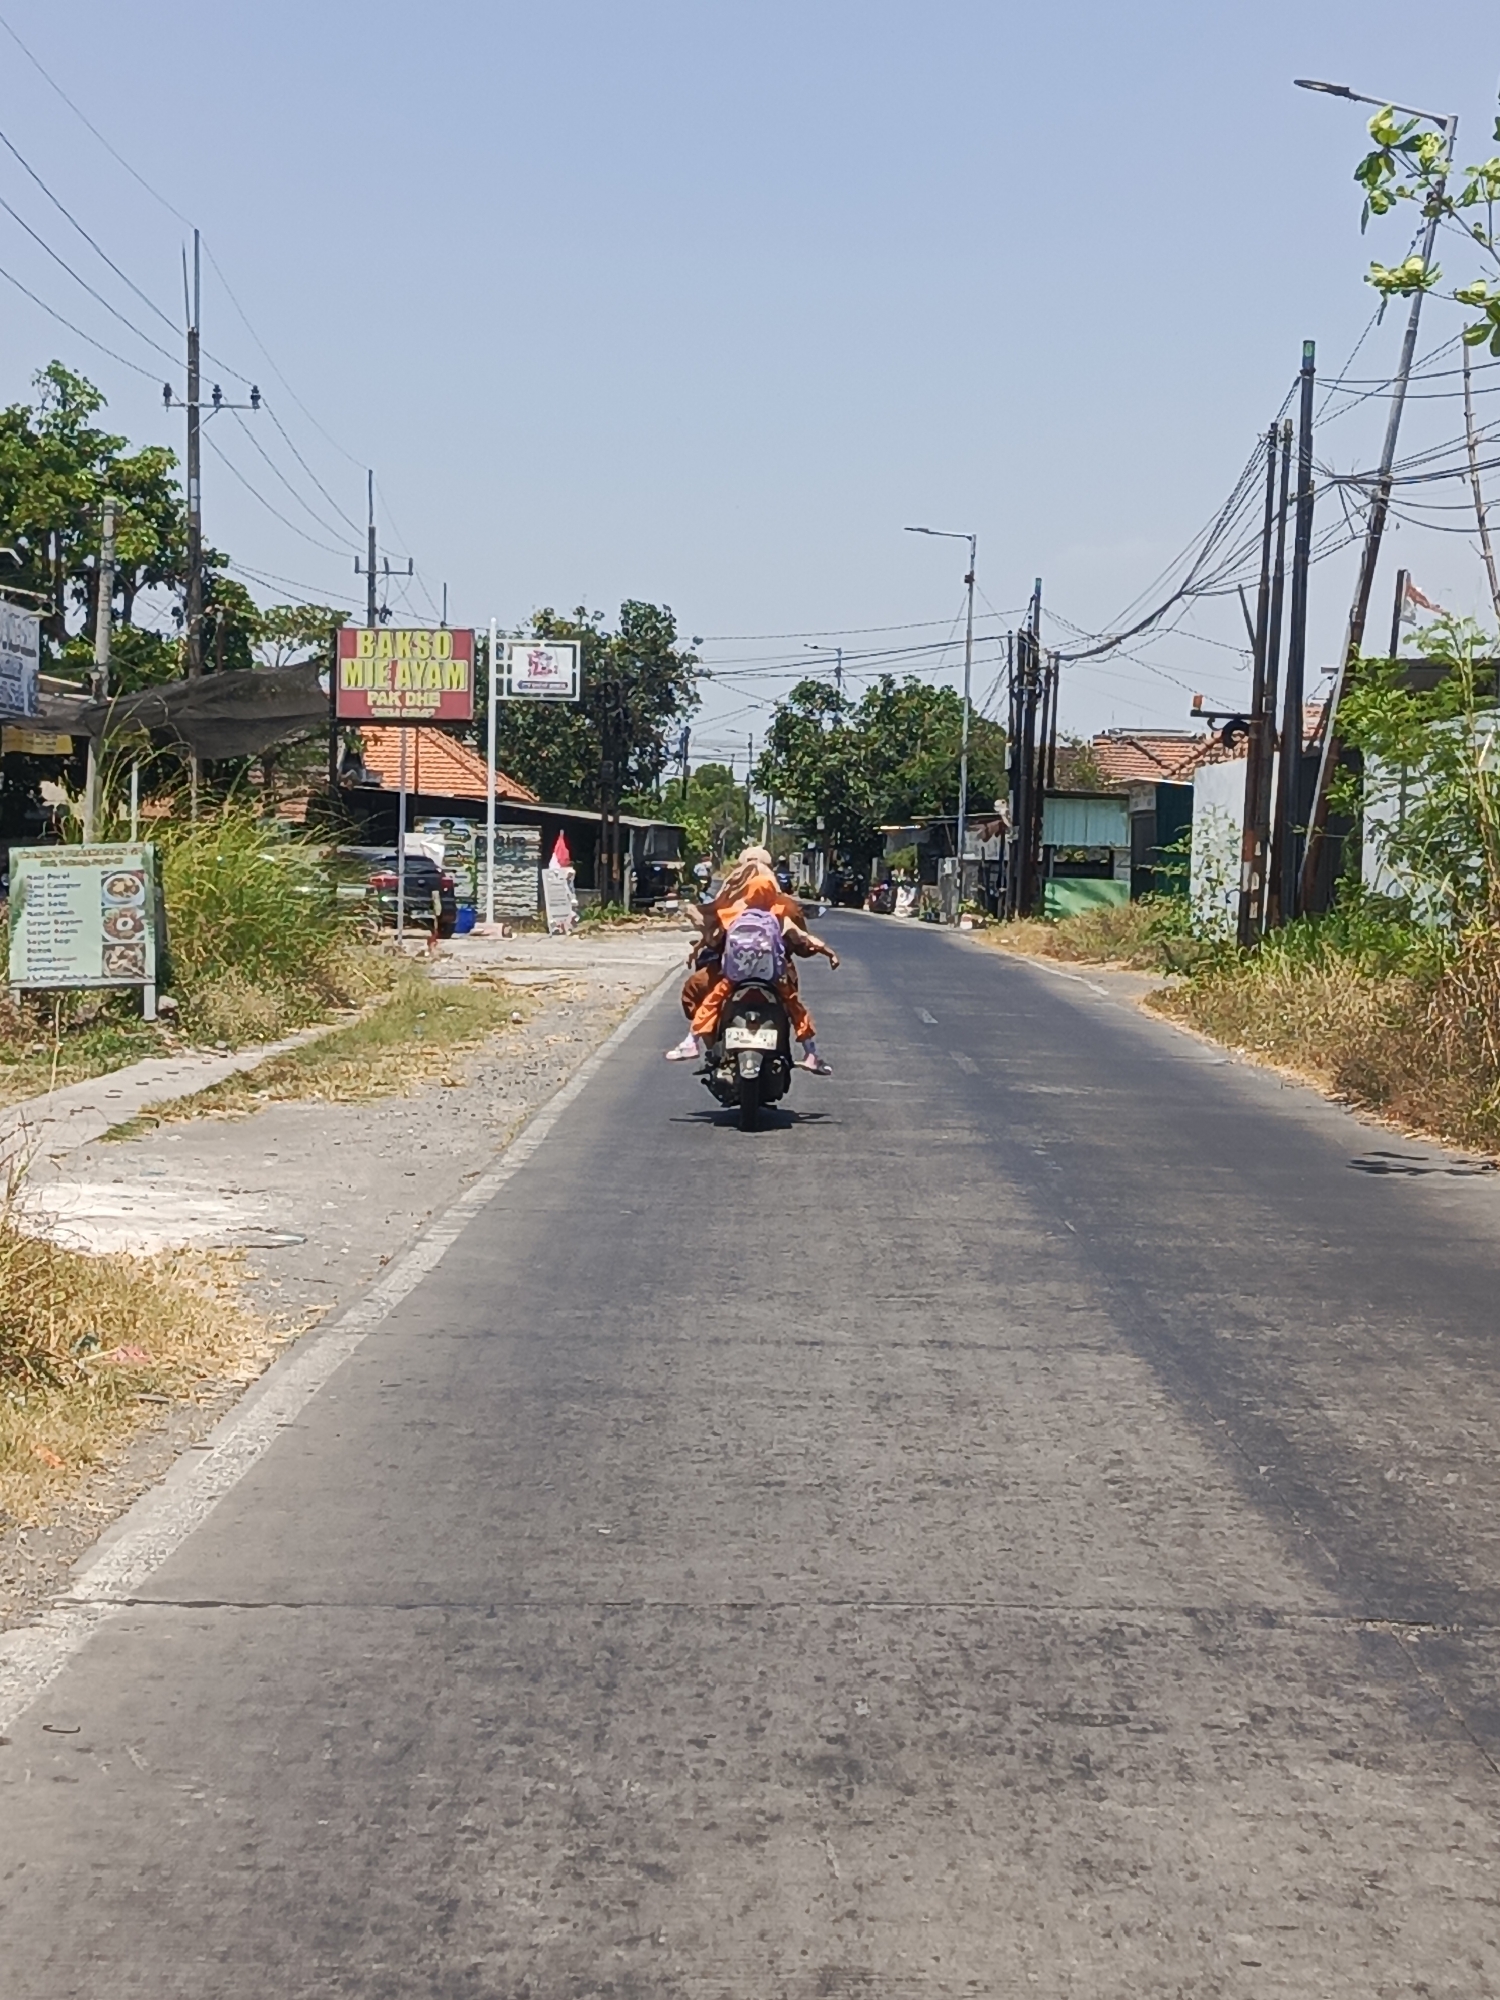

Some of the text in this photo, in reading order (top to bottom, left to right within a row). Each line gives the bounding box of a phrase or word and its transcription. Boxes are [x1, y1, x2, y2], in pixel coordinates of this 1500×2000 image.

[358, 630, 453, 659] BAKSO
[342, 660, 468, 691] MIE AYAM
[369, 691, 441, 708] PAK DHE
